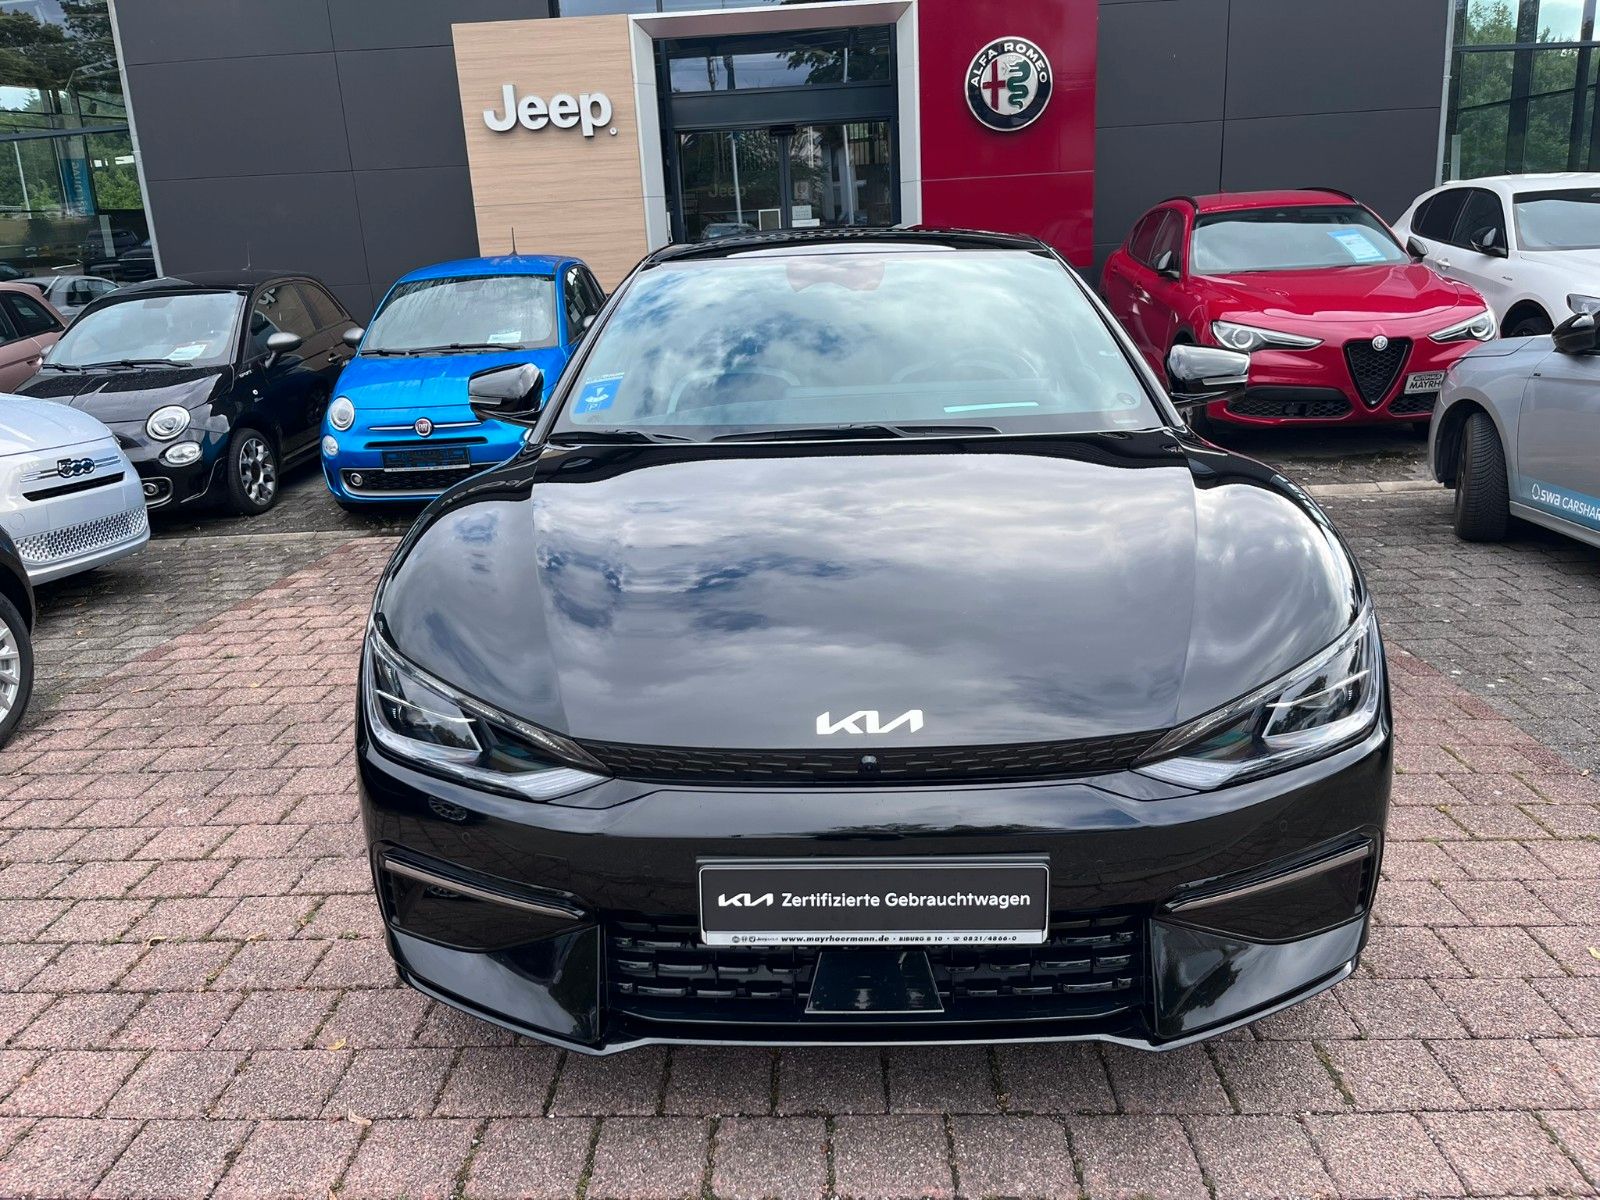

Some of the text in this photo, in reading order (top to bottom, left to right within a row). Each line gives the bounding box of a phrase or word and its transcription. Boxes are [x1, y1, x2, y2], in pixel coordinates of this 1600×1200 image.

[970, 42, 1048, 87] ALFA ROMEO
[483, 84, 612, 136] Jeep
[57, 458, 95, 478] 500
[1540, 489, 1561, 506] swa
[816, 709, 924, 735] KIA
[718, 892, 1031, 909] KIA Zertifizierte Gebrauchtwagen
[781, 934, 890, 943] www.mayrhoermann.de
